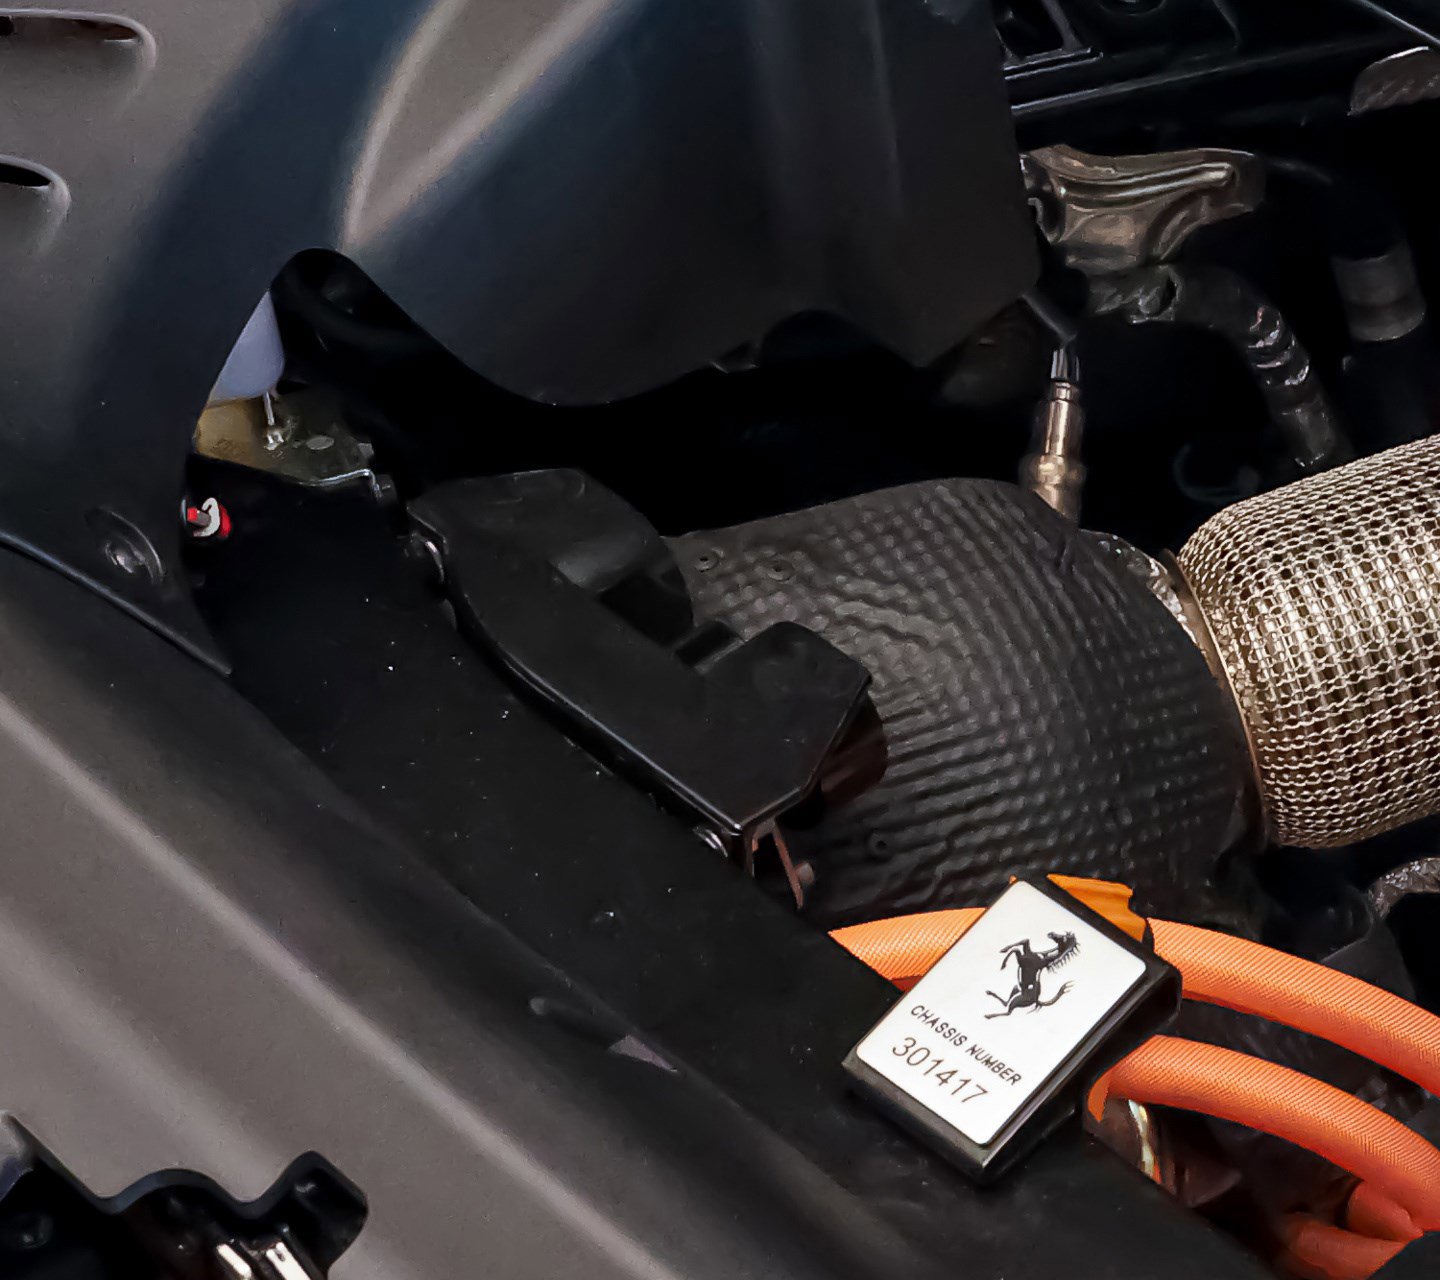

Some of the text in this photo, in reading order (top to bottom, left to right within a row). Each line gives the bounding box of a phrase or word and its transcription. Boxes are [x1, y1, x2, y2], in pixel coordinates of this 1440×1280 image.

[891, 1037, 987, 1102] 301417
[910, 1004, 1021, 1085] CHASSIS NUMBER
